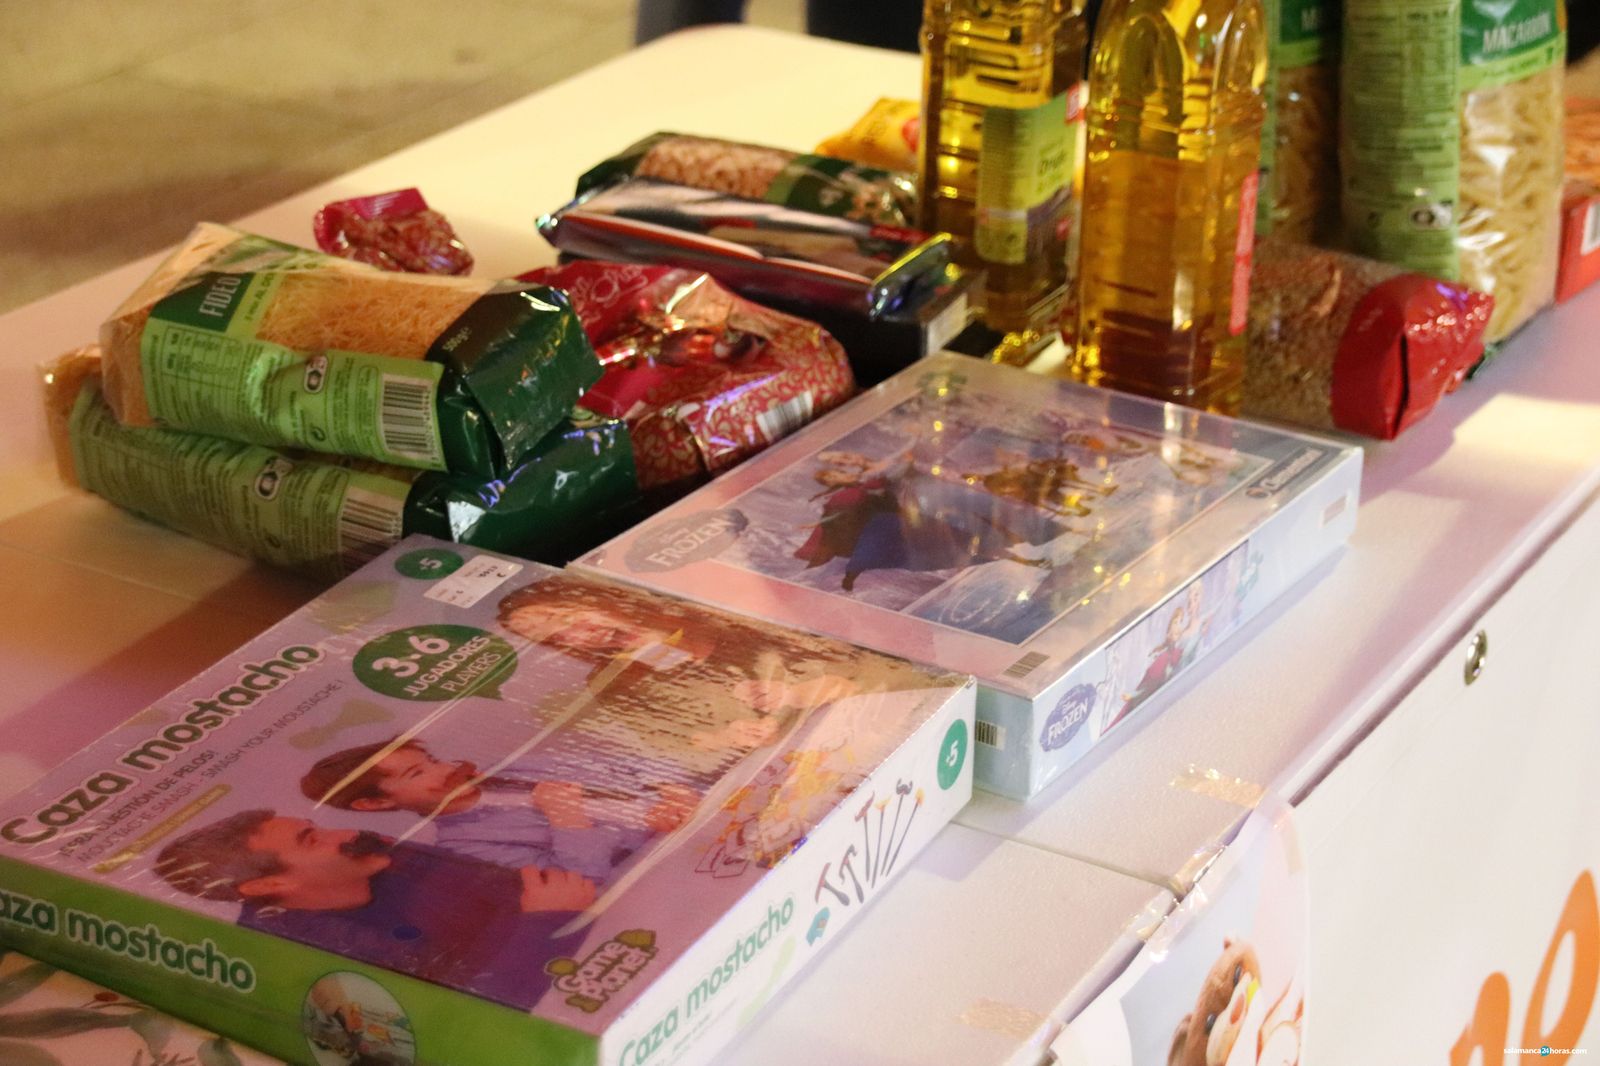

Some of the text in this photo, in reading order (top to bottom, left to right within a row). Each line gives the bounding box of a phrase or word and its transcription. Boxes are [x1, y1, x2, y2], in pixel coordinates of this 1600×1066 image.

[645, 517, 735, 567] FROZEN
[404, 635, 491, 697] JUGADORES
[440, 651, 501, 692] PLAYERS
[0, 771, 134, 844] Caza
[121, 645, 320, 770] mostacho
[1047, 698, 1089, 746] FROZEN
[156, 776, 178, 791] DE
[173, 748, 219, 778] PELOS!
[200, 748, 244, 779] SMASH
[243, 728, 273, 751] YOUR
[67, 910, 253, 991] mostacho
[556, 941, 624, 992] Game
[580, 946, 653, 1000] Planet
[619, 1006, 679, 1066] Caza
[686, 897, 793, 1018] mostacho
